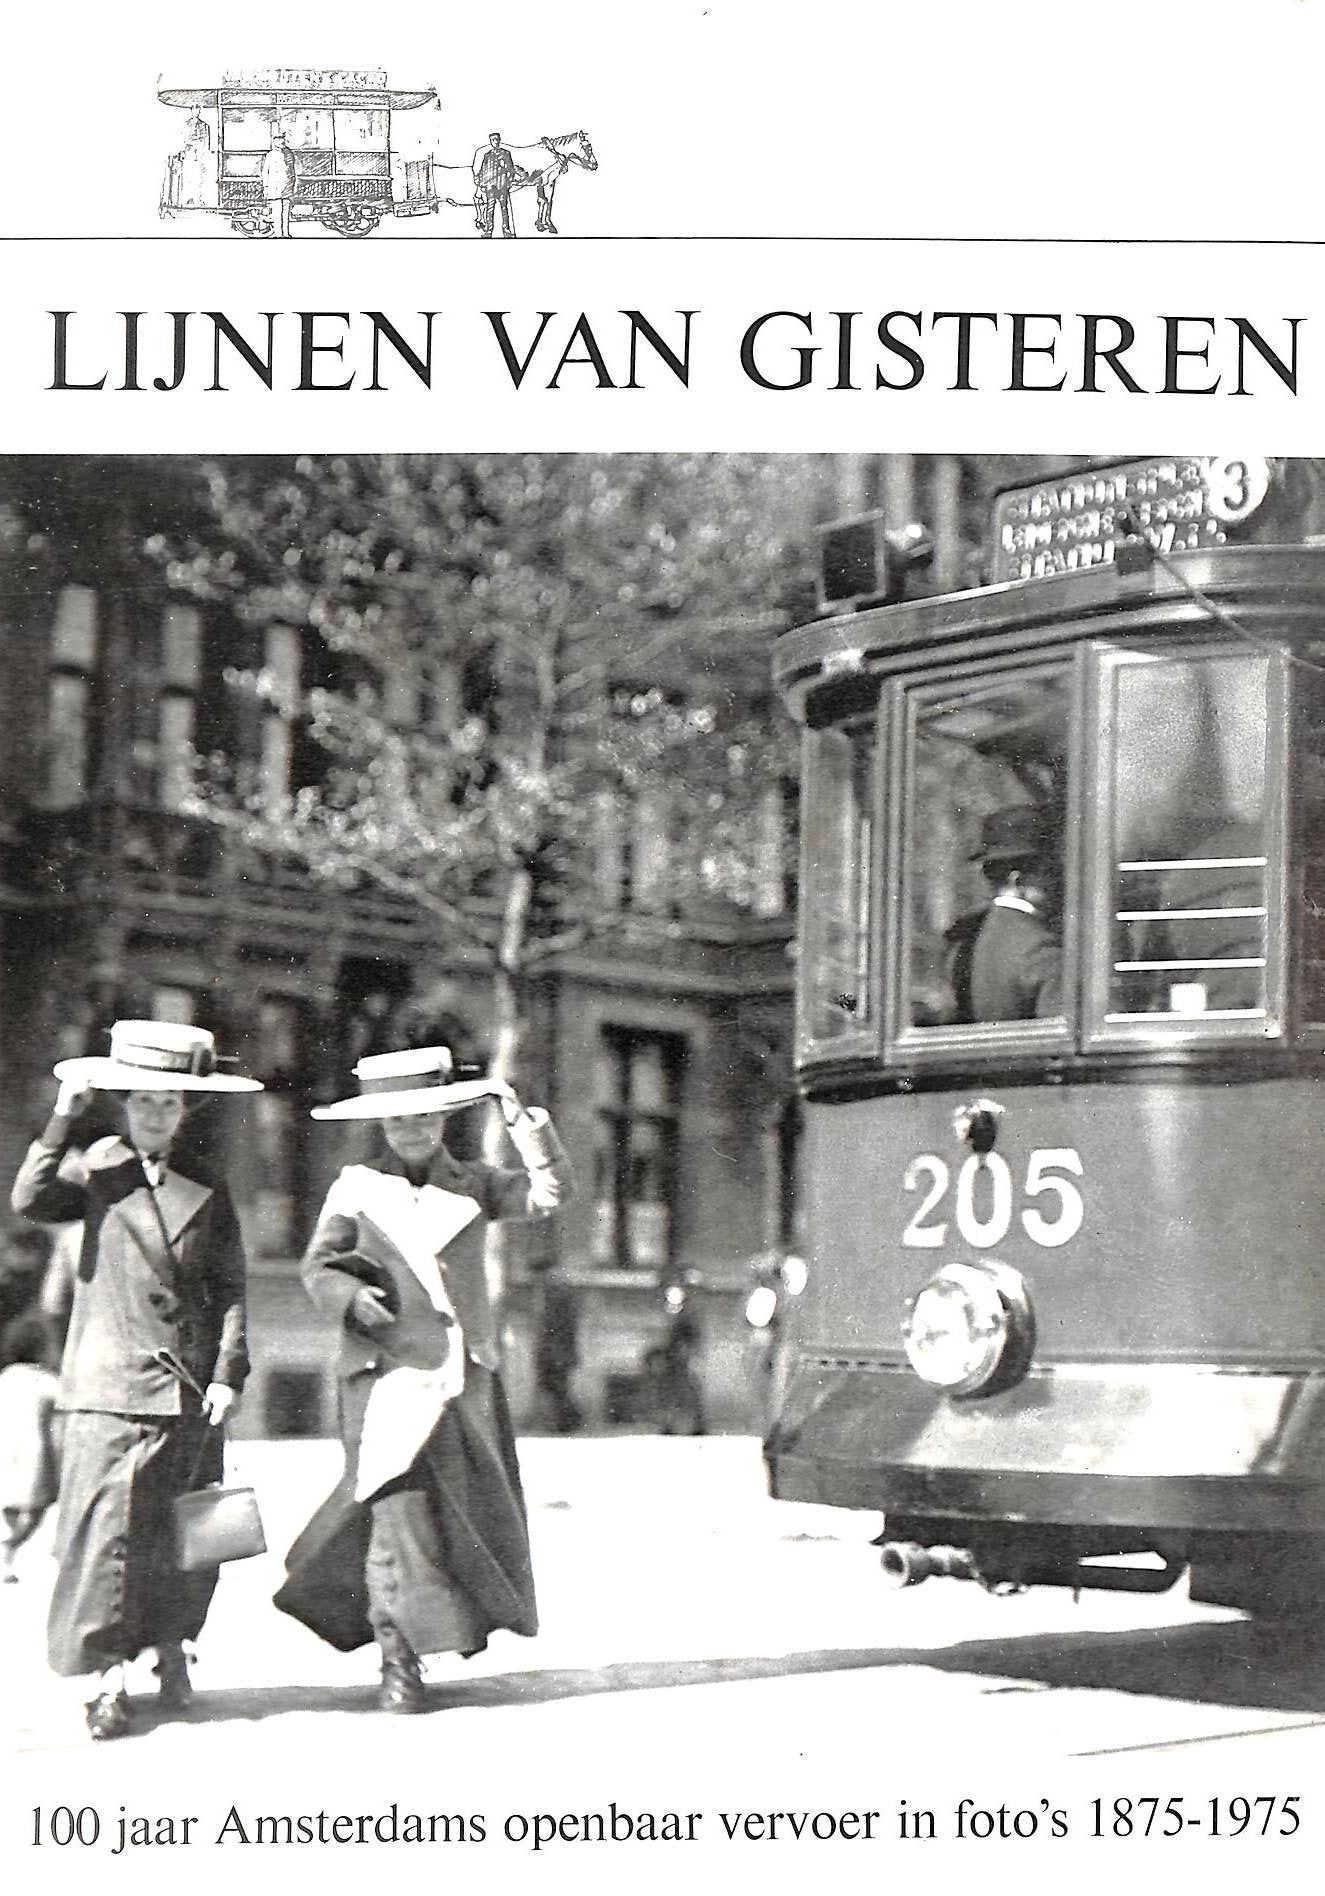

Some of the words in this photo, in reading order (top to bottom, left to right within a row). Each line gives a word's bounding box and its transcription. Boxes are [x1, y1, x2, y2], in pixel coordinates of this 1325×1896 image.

[45, 311, 442, 392] LIJNEN
[481, 311, 701, 391] VAN
[740, 311, 1307, 397] GISTEREN
[1223, 460, 1251, 511] 3
[903, 1148, 1085, 1248] 205
[28, 1806, 100, 1846] 100
[111, 1806, 199, 1855] jaar
[216, 1804, 487, 1845] Amsterdams
[504, 1803, 703, 1851] openbaar
[719, 1811, 881, 1842] vervoer
[898, 1800, 938, 1839] in
[1091, 1797, 1302, 1838] 1875-1975
